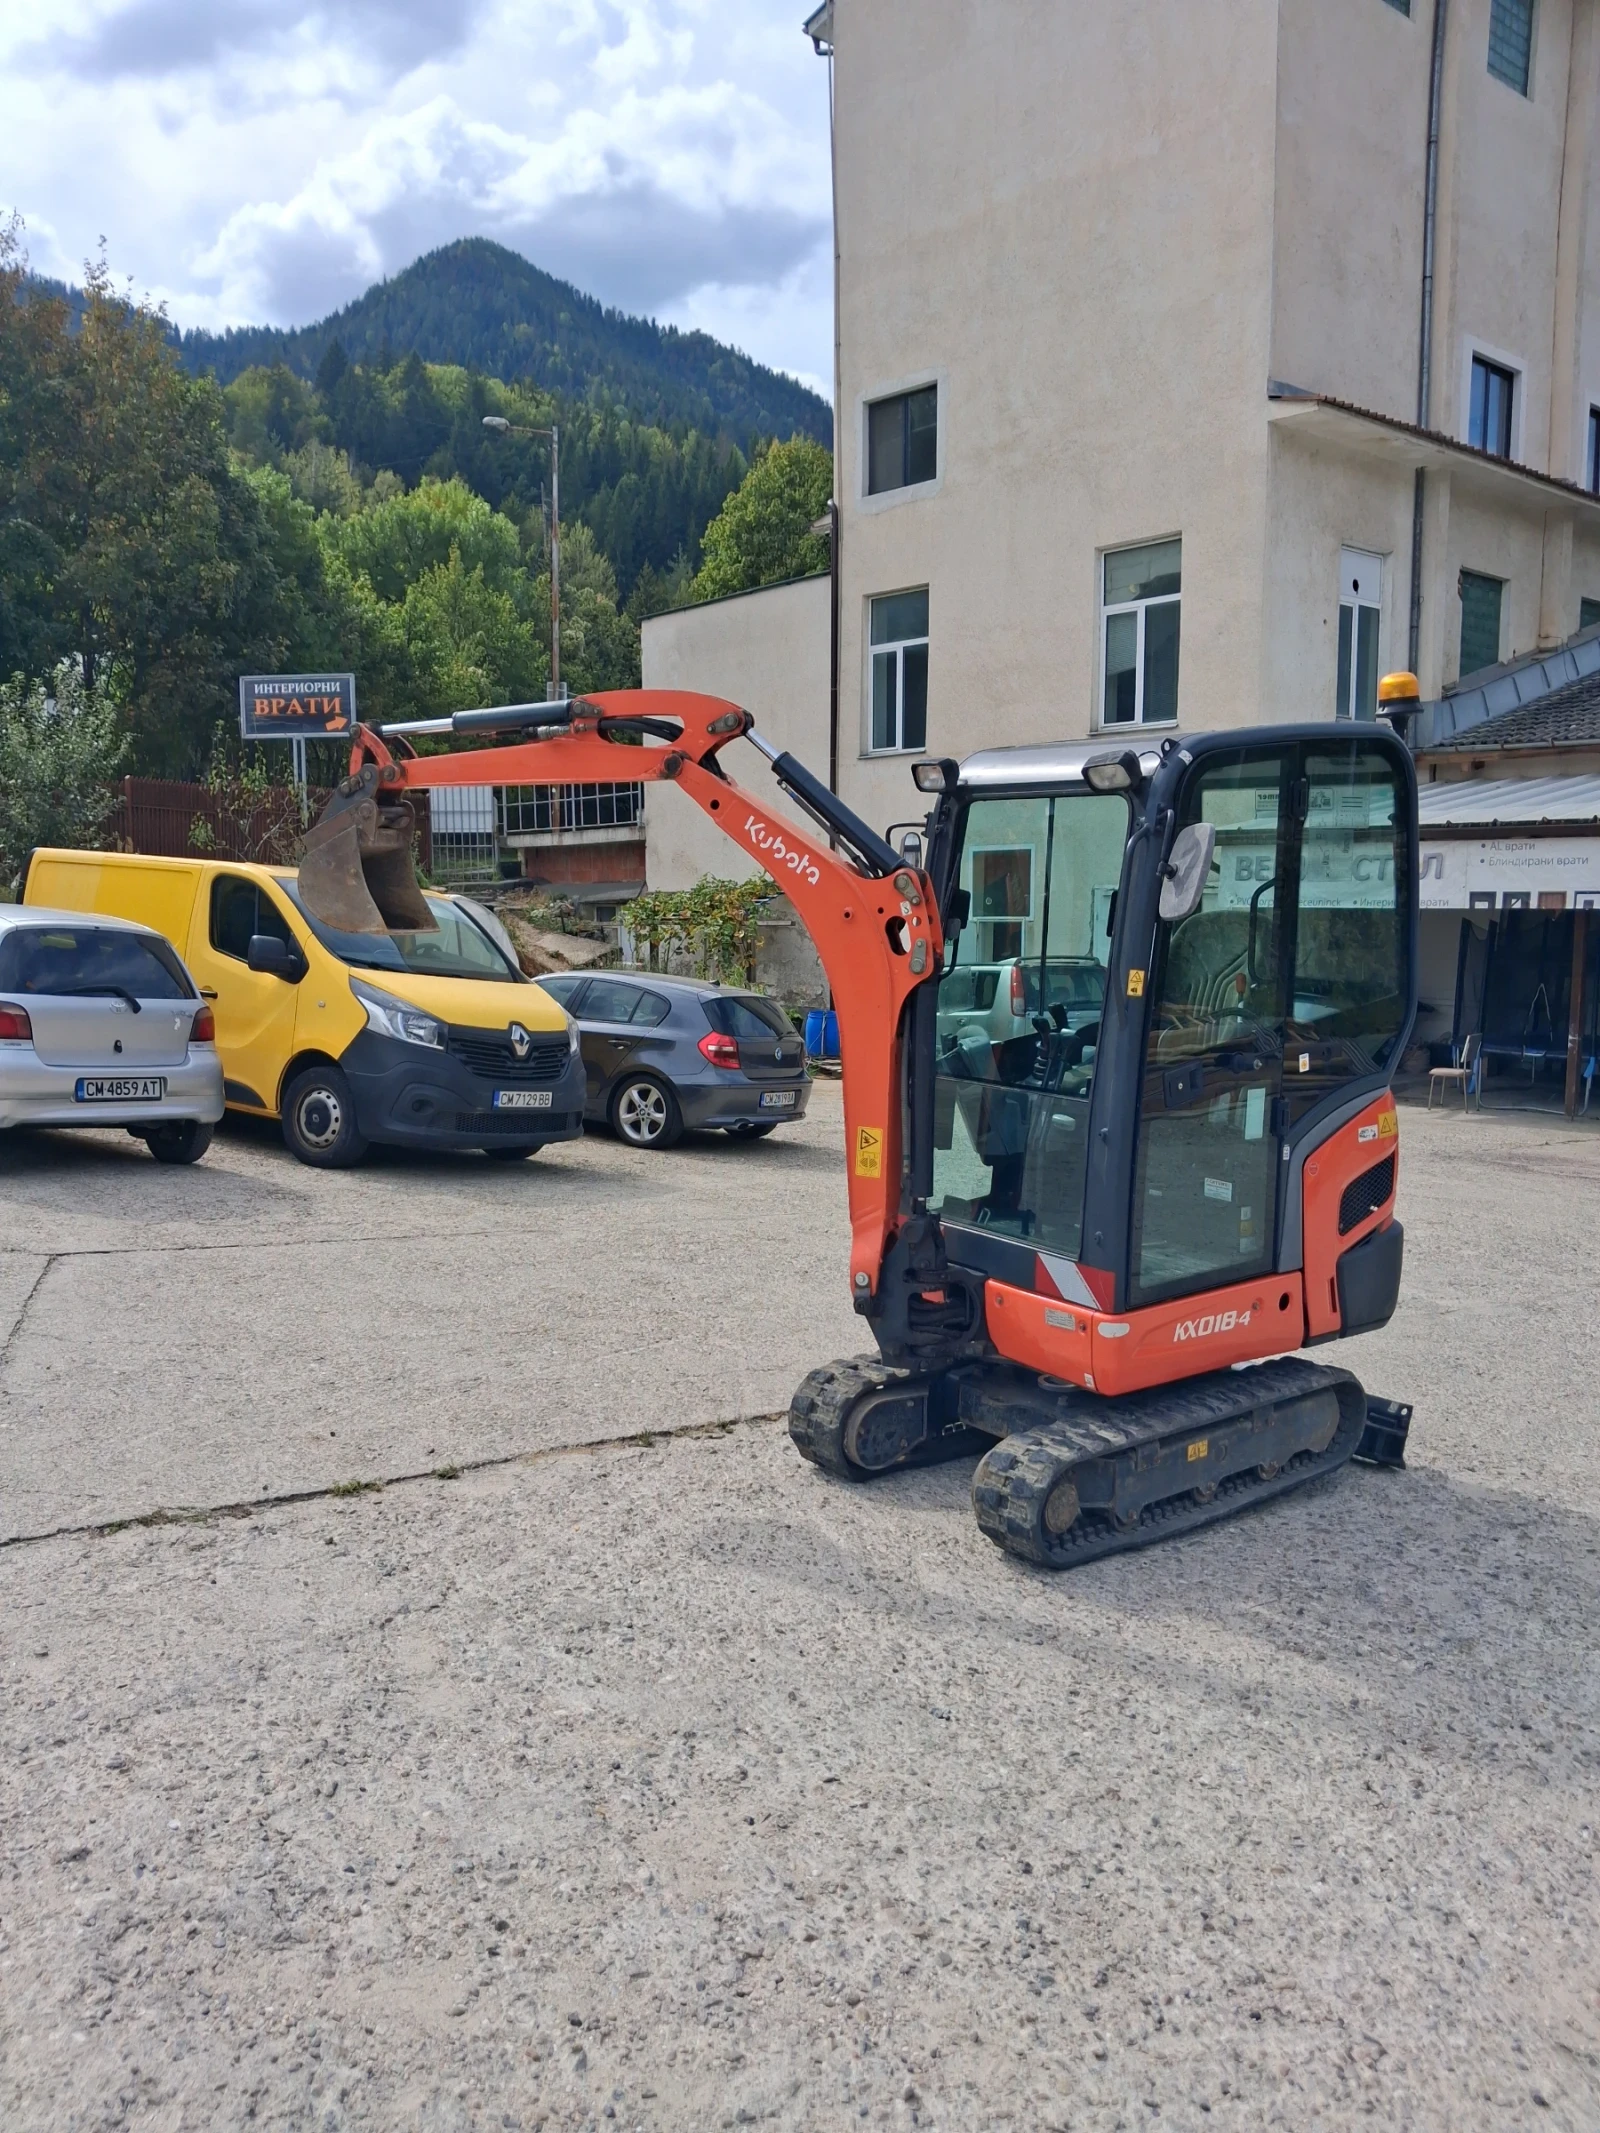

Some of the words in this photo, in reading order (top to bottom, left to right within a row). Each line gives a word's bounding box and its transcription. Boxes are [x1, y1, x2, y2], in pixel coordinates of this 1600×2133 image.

[254, 682, 340, 694] ИНТЕРИОРНИ
[254, 697, 342, 716] ВРАТИ
[744, 815, 820, 885] Kubota
[1505, 842, 1535, 852] врати
[1353, 852, 1444, 881] СТЛ
[1488, 857, 1553, 867] Блиндирани
[1556, 856, 1589, 866] врати
[1298, 898, 1341, 907] eceuninck
[1420, 898, 1449, 909] врати
[107, 1081, 139, 1096] 4859
[141, 1081, 158, 1095] AT
[1173, 1310, 1250, 1342] KX018-4
